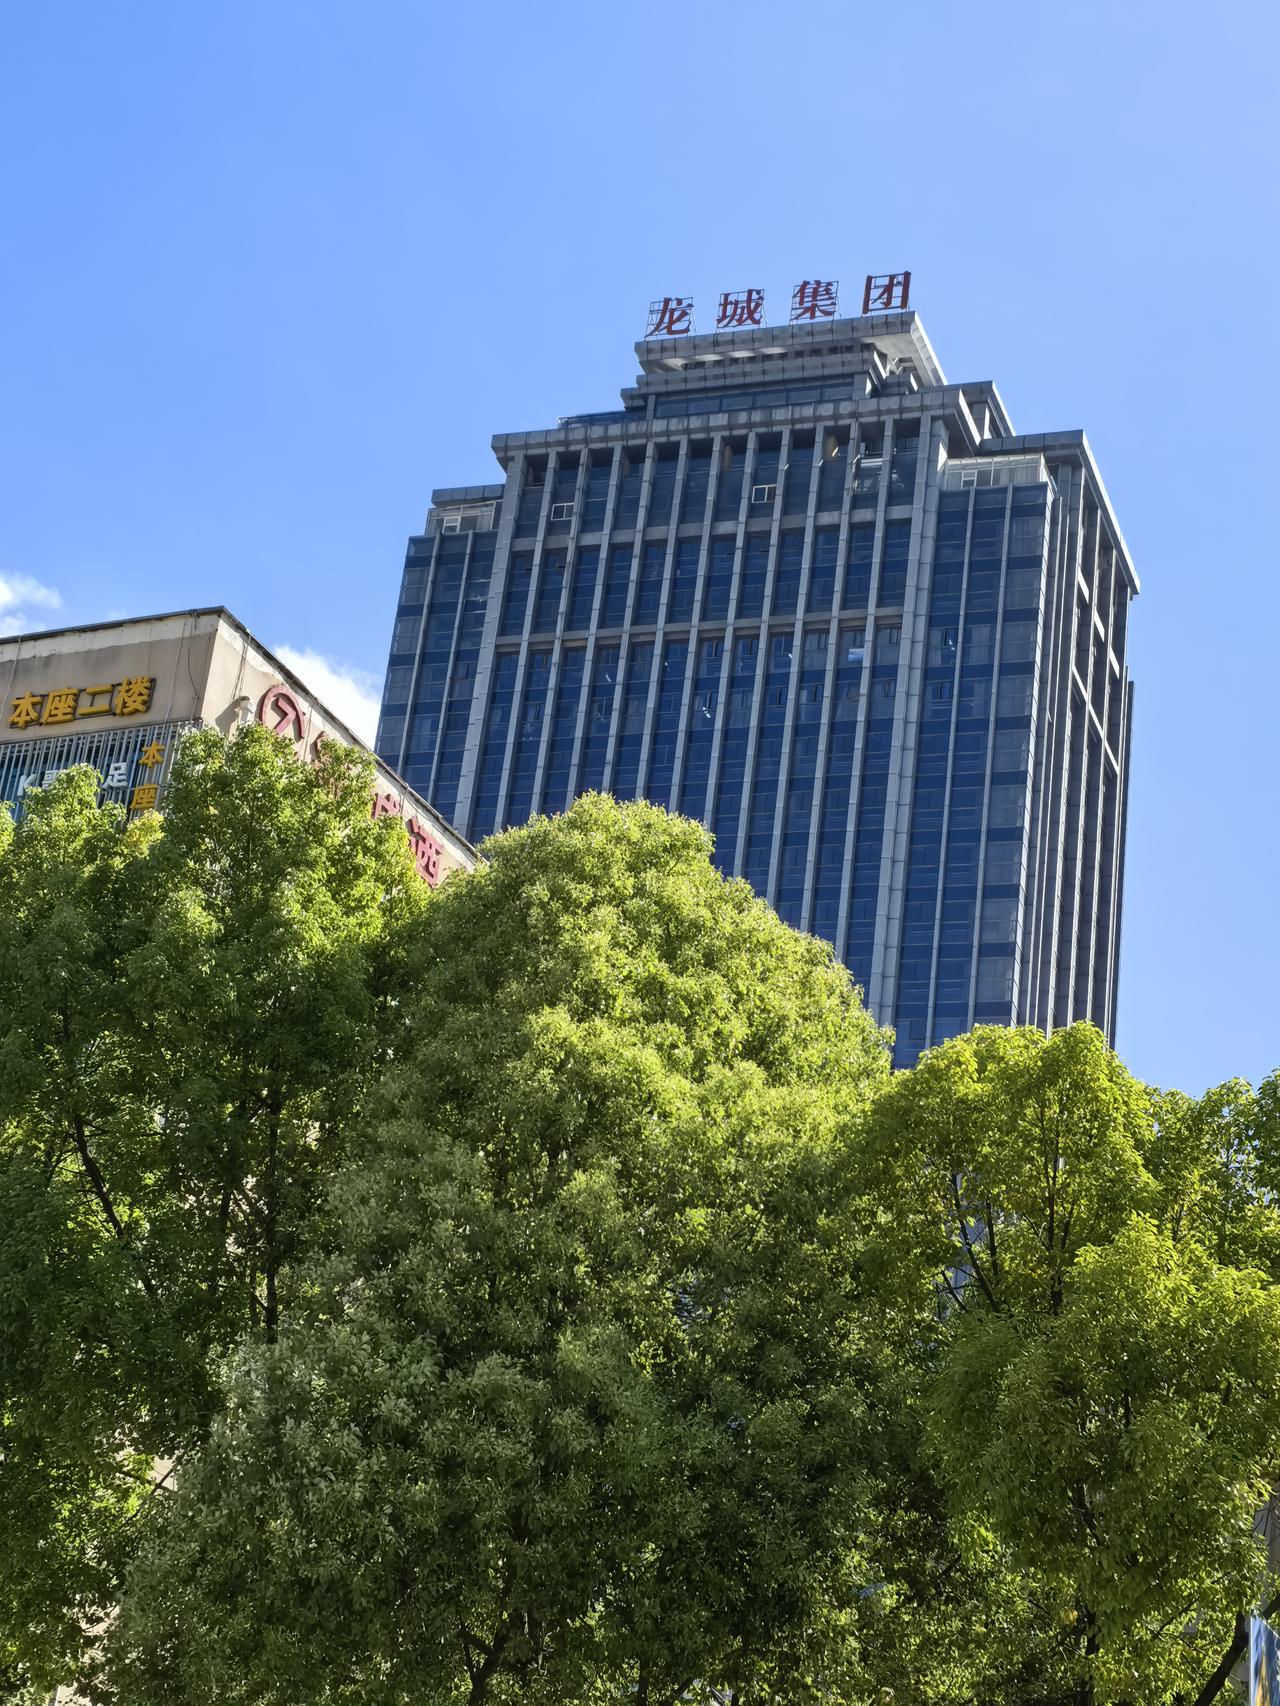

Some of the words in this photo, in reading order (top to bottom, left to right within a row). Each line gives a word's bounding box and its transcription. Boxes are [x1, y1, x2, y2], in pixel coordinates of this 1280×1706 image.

[646, 271, 912, 338] 龙城集团
[8, 675, 154, 730] 本座二楼
